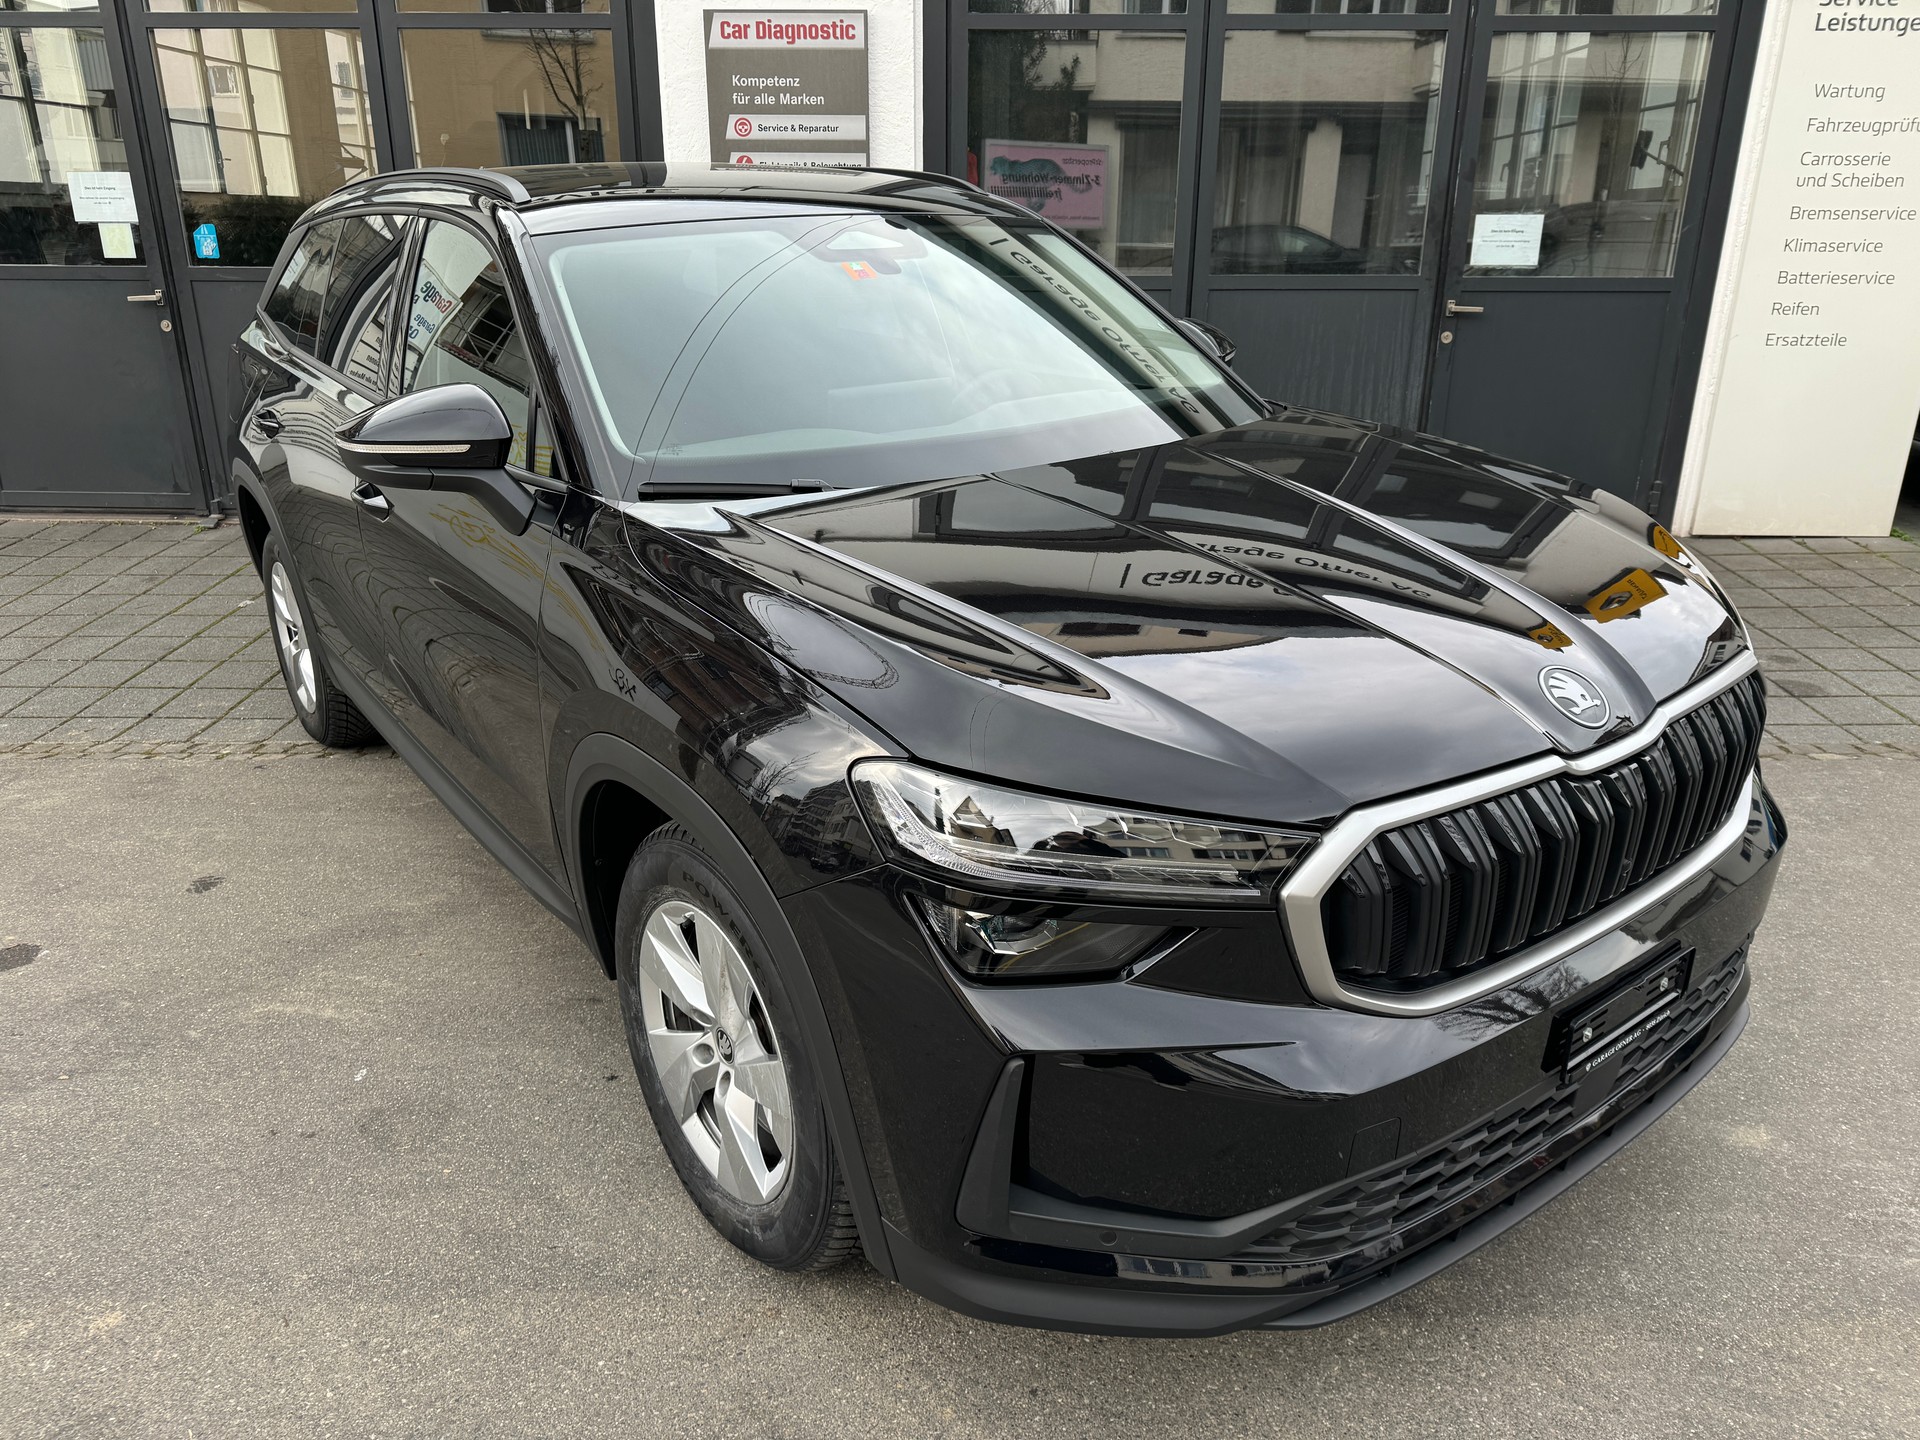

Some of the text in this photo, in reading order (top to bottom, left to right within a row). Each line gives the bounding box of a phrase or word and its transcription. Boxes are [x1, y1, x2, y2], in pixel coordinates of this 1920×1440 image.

[720, 19, 856, 45] Car Diagnostic
[732, 75, 800, 89] Kompetenz
[732, 92, 825, 105] für alle Marken
[1815, 83, 1886, 102] Wartung
[757, 123, 839, 134] Service & Reparatur
[1800, 151, 1891, 166] Carrosserie
[1796, 173, 1905, 187] und Scheiben
[1789, 206, 1917, 220] Bremsenservice
[1783, 238, 1884, 252] Klimaservice
[1777, 270, 1895, 285] Batterieservice
[1771, 302, 1820, 316] Reifen
[1765, 333, 1847, 347] Ersatzteile
